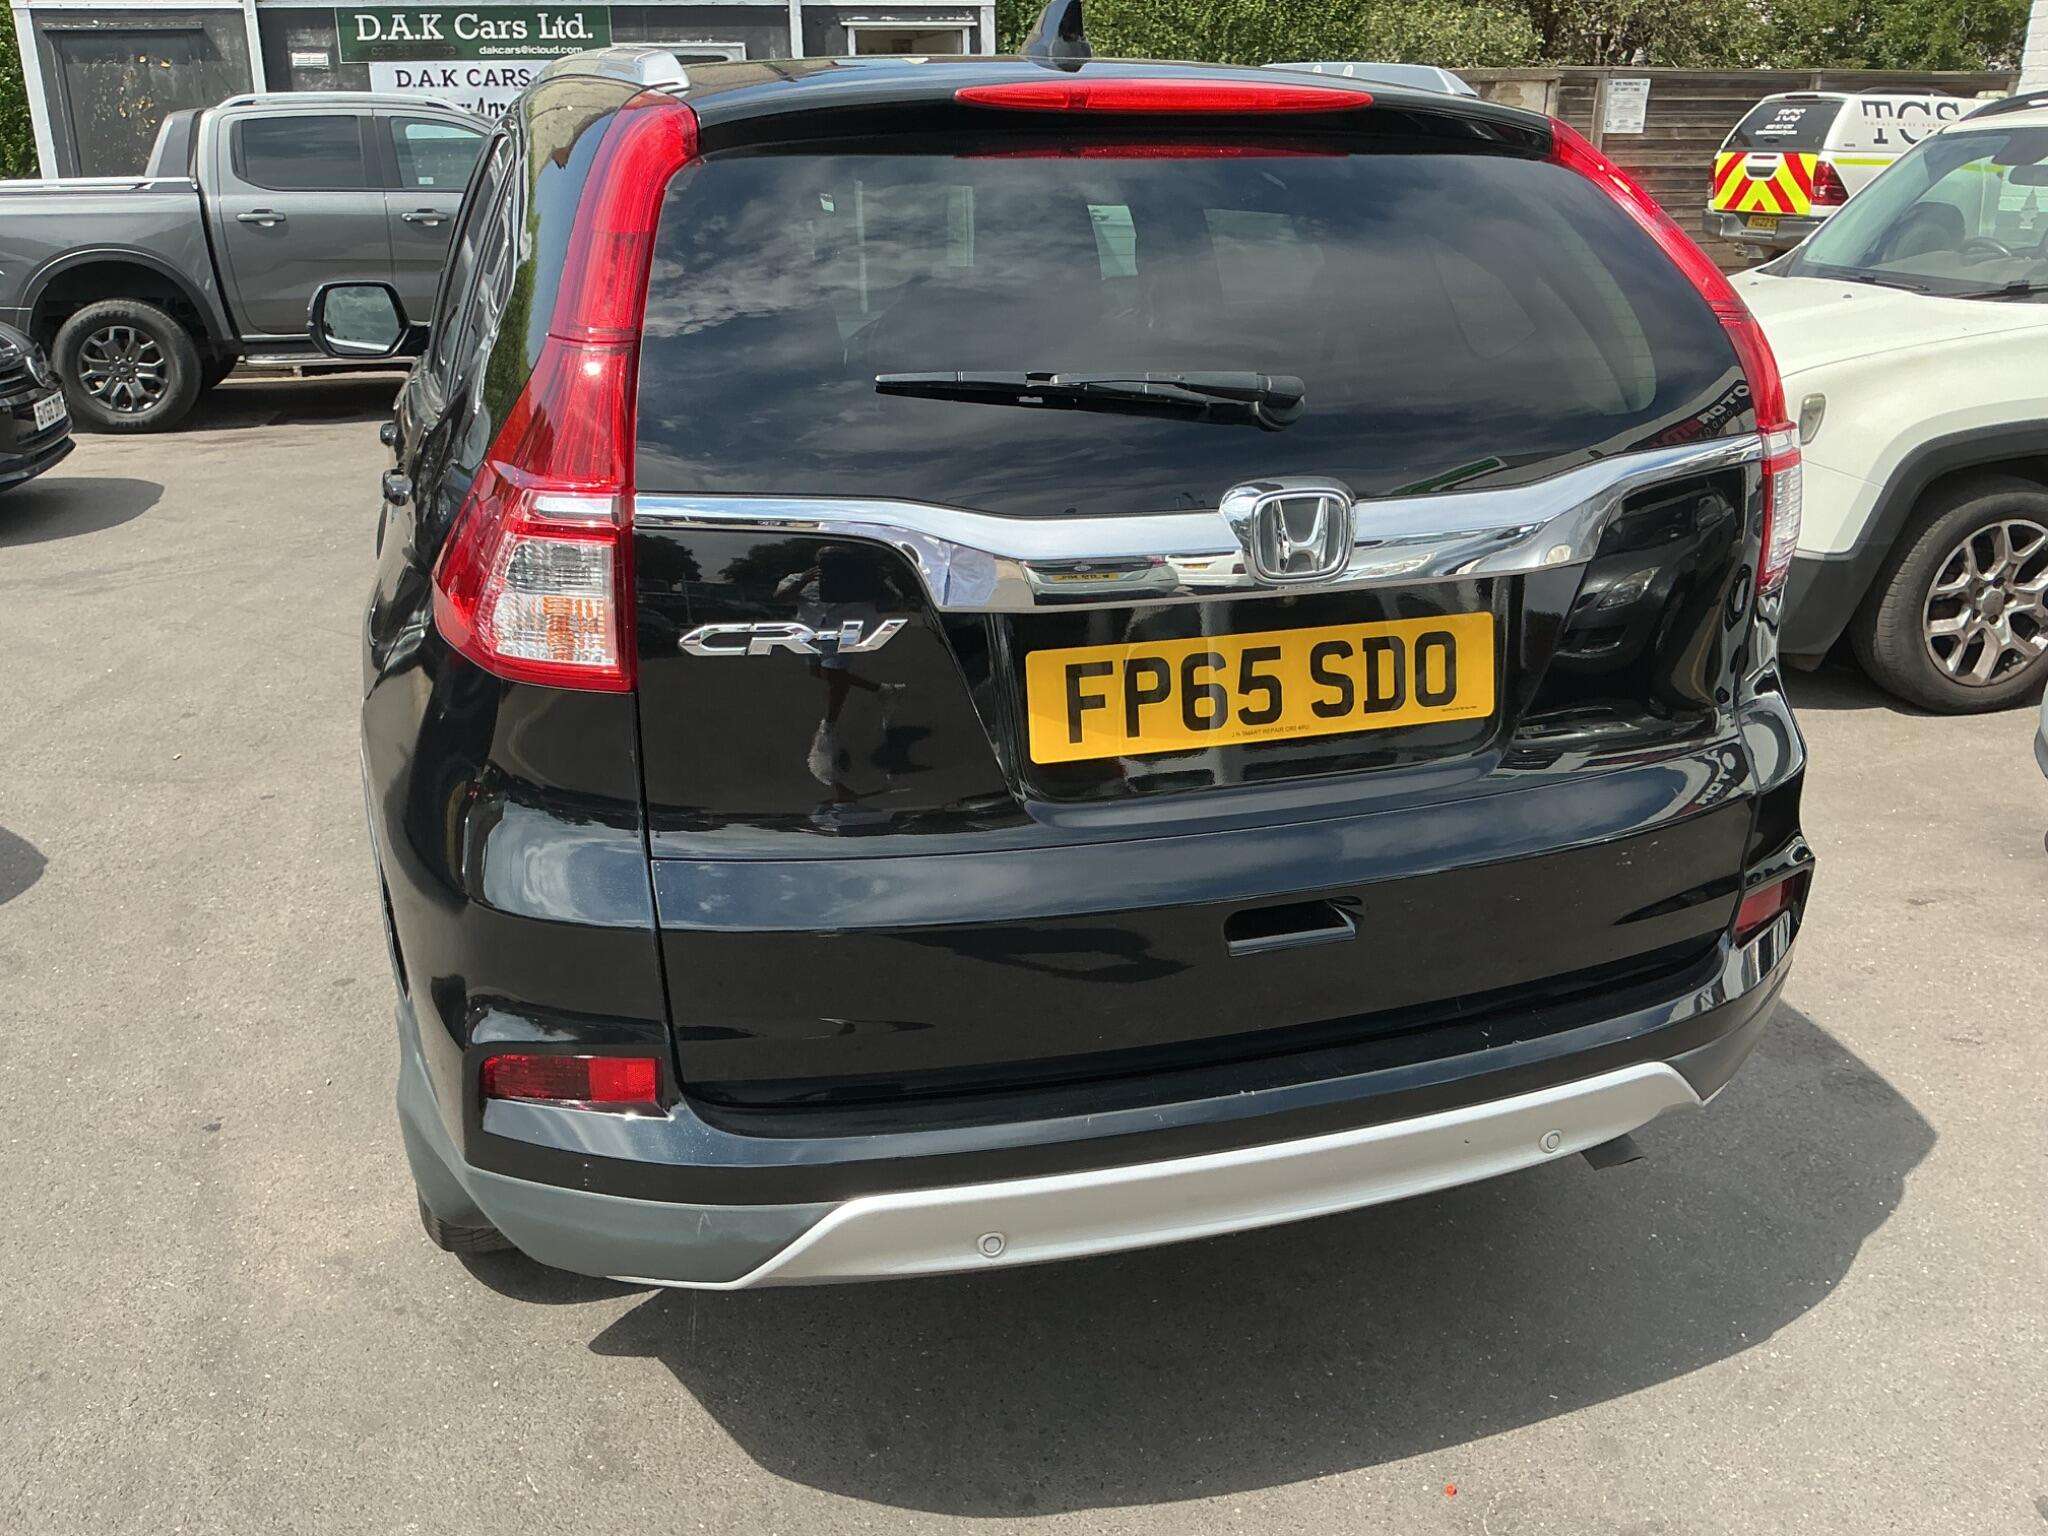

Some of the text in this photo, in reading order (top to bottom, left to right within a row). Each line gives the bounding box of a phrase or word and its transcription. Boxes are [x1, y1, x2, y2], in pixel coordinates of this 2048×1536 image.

[354, 13, 594, 41] D.A.K Cars Ltd.
[479, 45, 583, 55] dakcars@icloud.com
[395, 68, 531, 88] D.A.K CARS
[679, 619, 908, 656] CR-V
[1065, 630, 1457, 745] FP65 SDO
